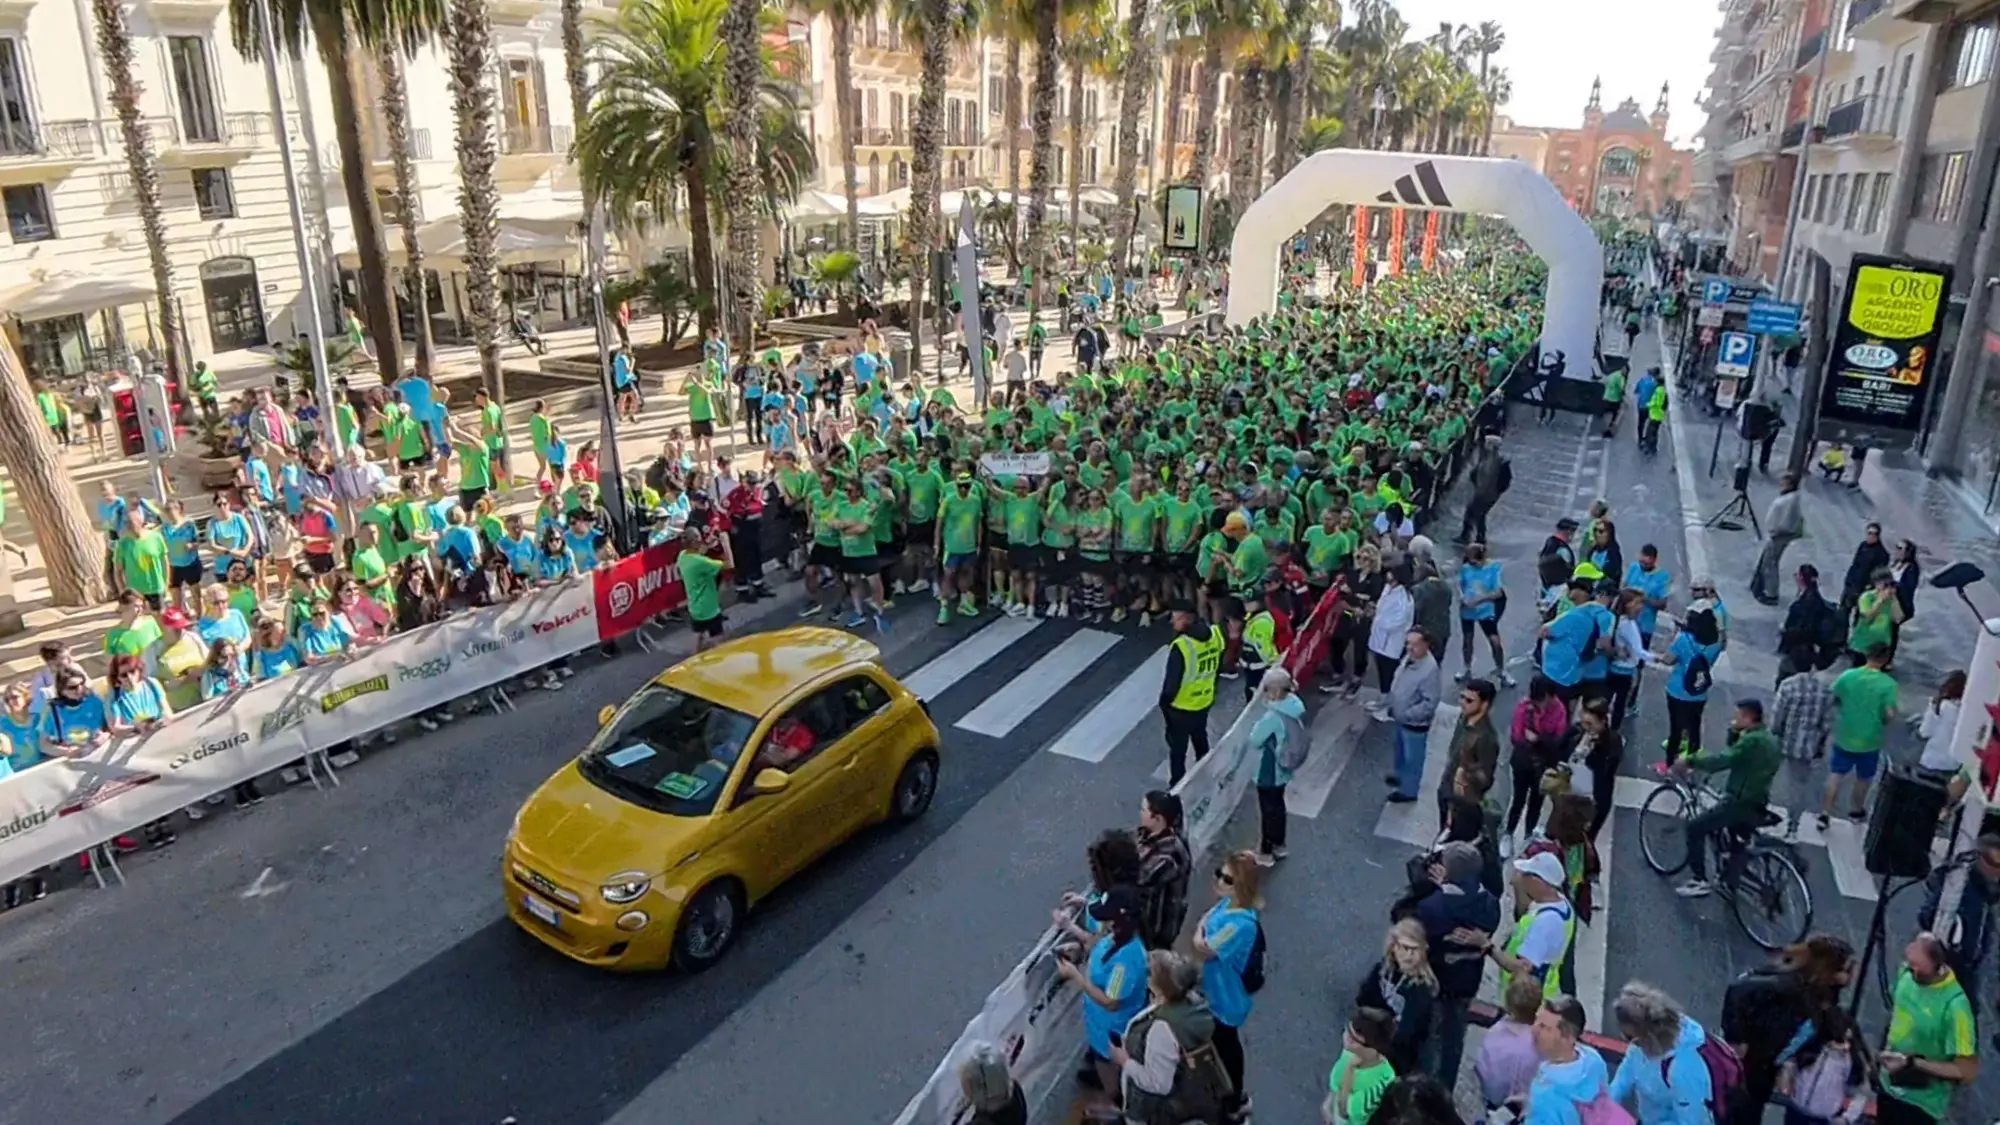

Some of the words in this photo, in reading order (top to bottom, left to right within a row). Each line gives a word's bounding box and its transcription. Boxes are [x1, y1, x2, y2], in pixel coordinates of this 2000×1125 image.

[1707, 281, 1723, 301] P
[1890, 275, 1939, 301] ORO
[1725, 335, 1749, 362] P
[1862, 379, 1892, 392] BARI
